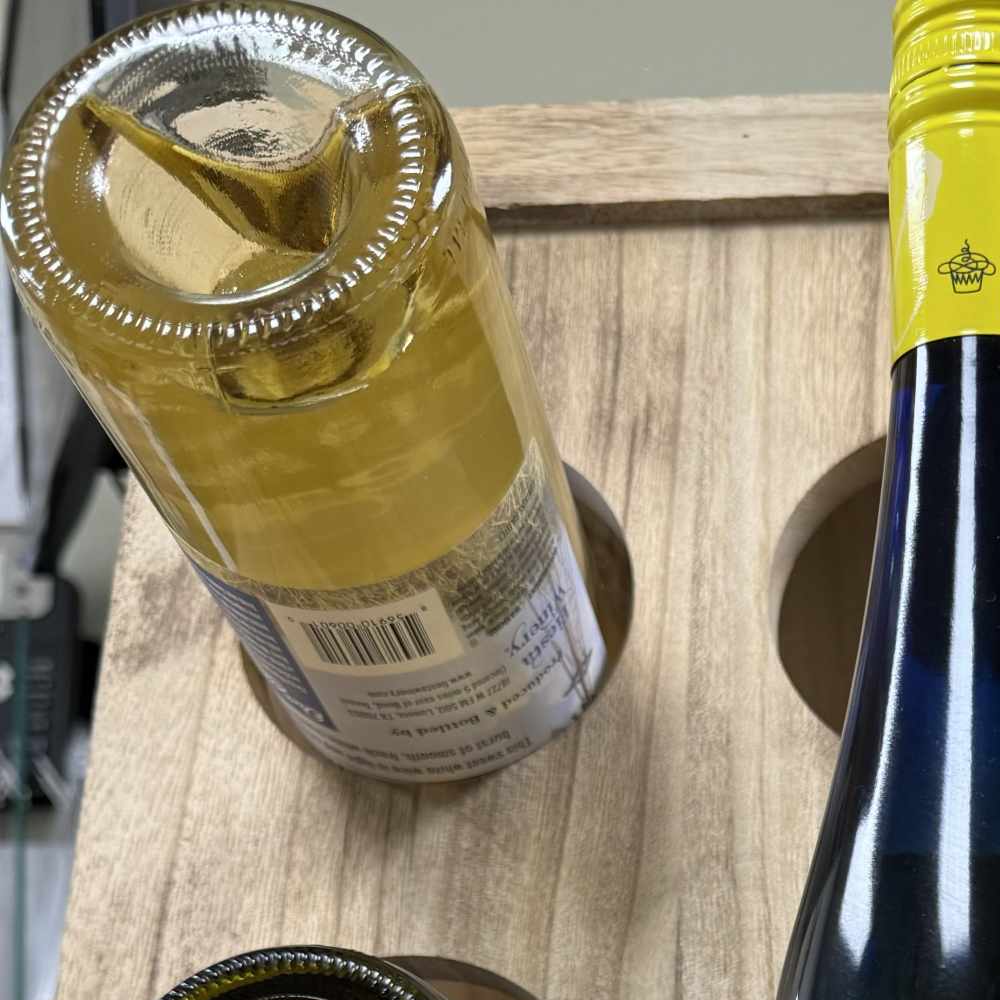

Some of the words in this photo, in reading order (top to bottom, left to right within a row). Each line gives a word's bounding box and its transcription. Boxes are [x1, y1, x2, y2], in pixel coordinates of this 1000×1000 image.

[484, 706, 496, 717] &
[415, 714, 480, 736] Bottled
[390, 727, 412, 738] by
